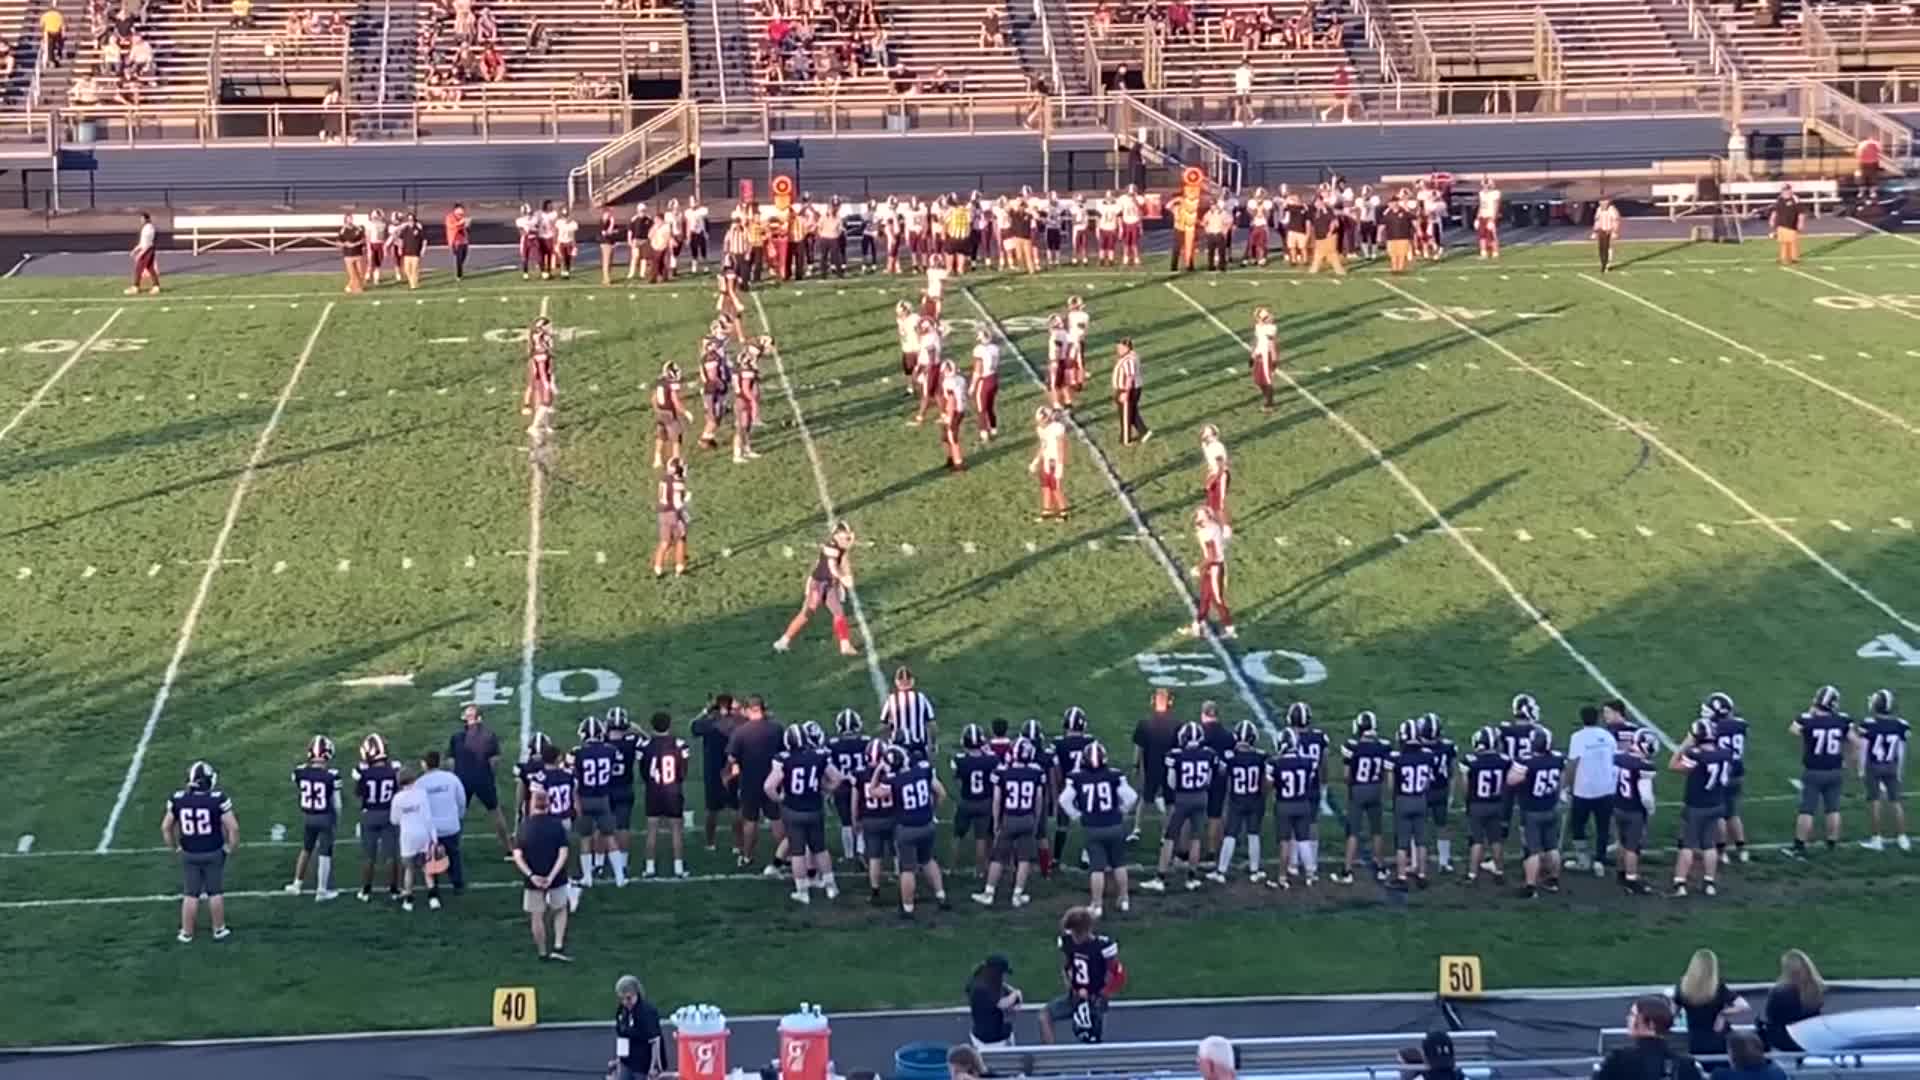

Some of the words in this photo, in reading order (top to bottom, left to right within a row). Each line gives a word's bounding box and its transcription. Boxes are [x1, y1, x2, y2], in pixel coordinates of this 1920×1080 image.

[1135, 650, 1328, 686] 50
[431, 667, 623, 706] 40
[1504, 736, 1532, 760] 12
[1812, 728, 1842, 755] 76
[1871, 734, 1899, 762] 47
[582, 757, 611, 787] 22
[650, 755, 676, 784] 48
[791, 765, 818, 795] 64
[1181, 760, 1210, 789] 25
[1233, 766, 1260, 794] 20
[1281, 769, 1306, 798] 31
[1401, 764, 1429, 793] 36
[1477, 769, 1502, 798] 61
[1532, 768, 1561, 797] 65
[300, 782, 327, 809] 23
[365, 779, 394, 803] 16
[901, 779, 929, 810] 68
[1005, 780, 1035, 809] 39
[1082, 781, 1113, 813] 79
[180, 808, 212, 836] 62
[1073, 957, 1089, 985] 3
[1449, 961, 1473, 992] 50
[501, 992, 526, 1021] 40
